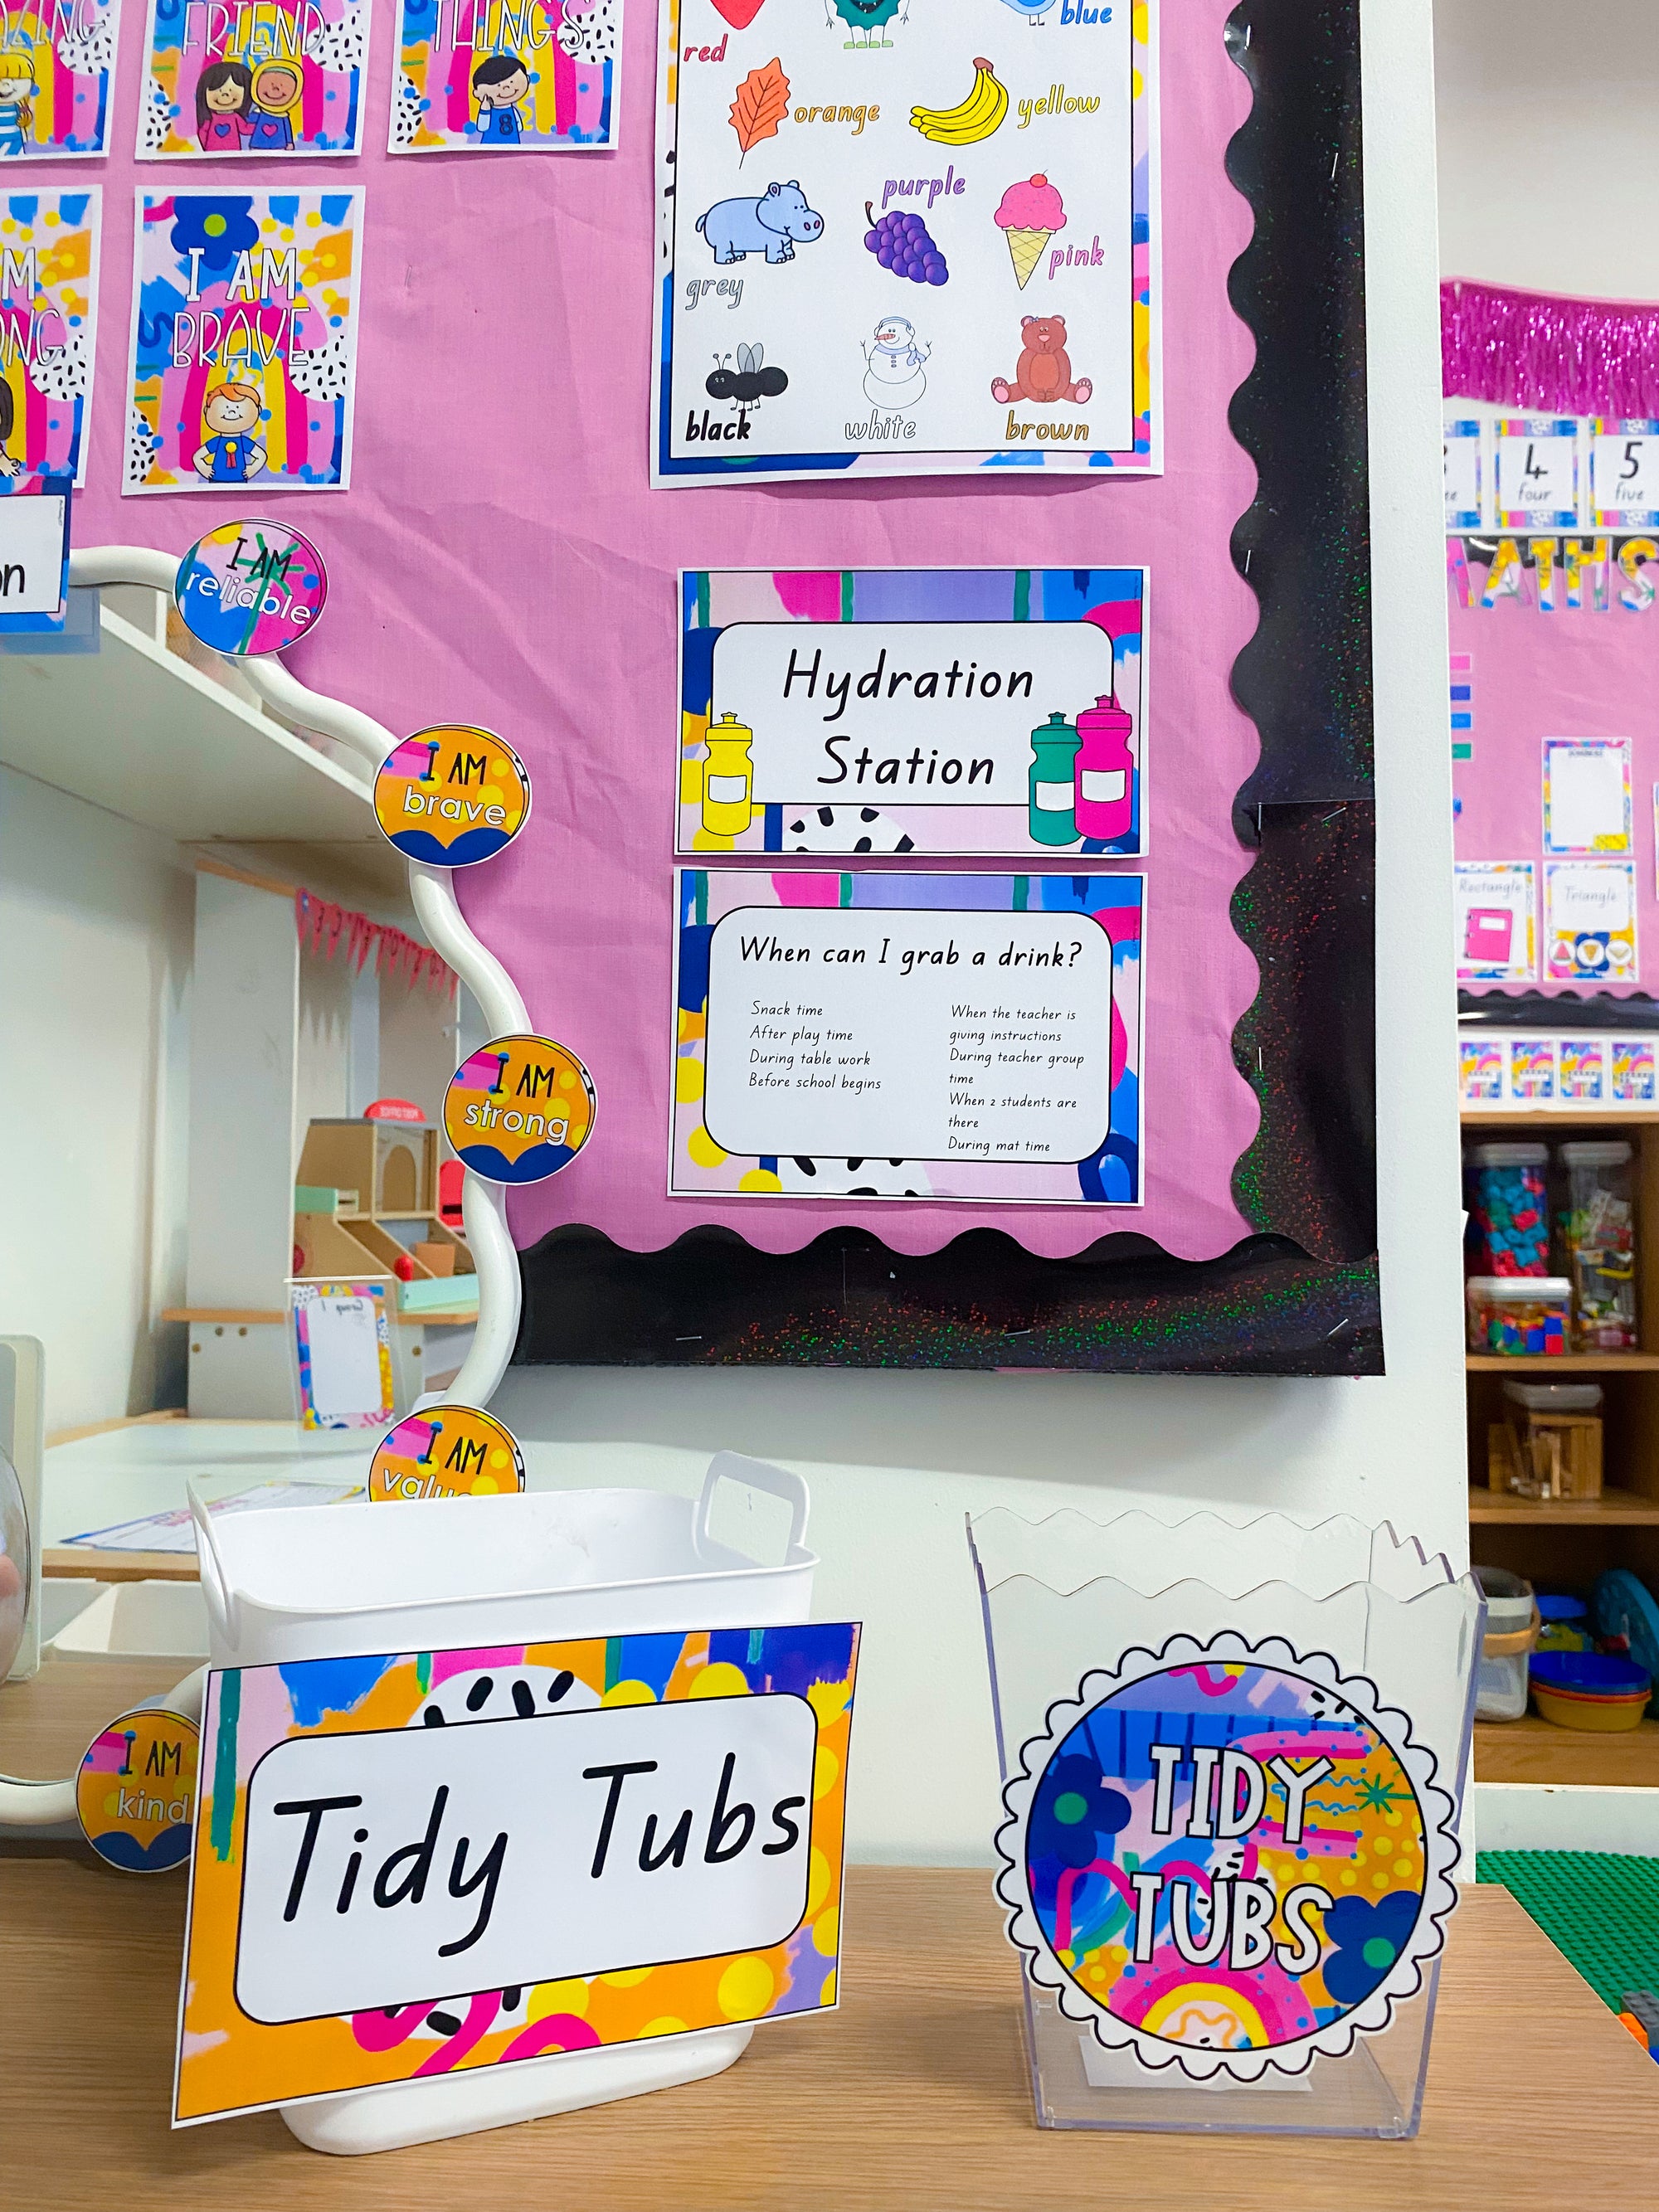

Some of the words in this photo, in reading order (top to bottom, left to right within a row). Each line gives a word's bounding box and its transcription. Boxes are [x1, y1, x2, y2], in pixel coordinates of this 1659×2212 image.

[0, 0, 105, 46] ZING
[182, 1, 326, 56] FRIEND
[433, 0, 585, 52] THINGS
[1061, 0, 1112, 24] blue
[684, 35, 727, 62] red
[794, 102, 879, 135] orange
[1017, 85, 1100, 129] yellow
[882, 166, 966, 208] purple
[185, 247, 205, 302] I
[226, 248, 297, 301] AM
[1049, 236, 1104, 279] pink
[685, 276, 743, 310] grey
[0, 309, 64, 367] NG
[173, 308, 310, 368] BRAVE
[685, 411, 751, 441] black
[844, 411, 916, 440] white
[1006, 411, 1088, 441] brown
[1525, 443, 1549, 479] 4
[1619, 440, 1643, 479] 5
[226, 537, 248, 571] I
[250, 547, 292, 581] AM
[185, 571, 311, 625] reliable
[783, 649, 1033, 722] Hydration
[422, 746, 440, 781] I
[447, 752, 487, 785] AM
[817, 736, 995, 785] Station
[402, 785, 506, 825] brave
[1459, 878, 1523, 899] Rectangle
[1564, 885, 1618, 908] Triangle
[741, 936, 810, 963] When
[823, 949, 866, 964] can
[878, 938, 891, 964] I
[899, 939, 960, 976] grab
[971, 951, 985, 966] a
[998, 941, 1082, 968] drink?
[751, 1000, 791, 1015] Snack
[796, 1004, 823, 1016] time
[951, 1004, 987, 1018] When
[992, 1005, 1010, 1019] the
[1016, 1006, 1062, 1020] teacher
[1067, 1009, 1076, 1020] is
[749, 1024, 787, 1039] After
[791, 1025, 820, 1047] play
[826, 1029, 853, 1041] time
[949, 1030, 985, 1046] giving
[990, 1030, 1062, 1042] instructions
[491, 1056, 509, 1094] I
[515, 1063, 555, 1098] AM
[749, 1048, 795, 1070] During
[800, 1050, 832, 1065] table
[838, 1051, 871, 1066] work
[950, 1048, 992, 1068] During
[997, 1049, 1044, 1063] teacher
[1048, 1055, 1084, 1069] group
[748, 1072, 790, 1087] Before
[795, 1073, 836, 1088] school
[841, 1074, 882, 1096] begins
[949, 1074, 974, 1084] time
[950, 1091, 985, 1106] When
[990, 1098, 996, 1106] 2
[1000, 1093, 1052, 1108] students
[1057, 1100, 1078, 1108] are
[464, 1099, 569, 1146] strong
[948, 1114, 979, 1128] there
[947, 1135, 990, 1156] During
[995, 1140, 1020, 1151] mat
[1025, 1141, 1050, 1152] time
[420, 1427, 441, 1465] I
[444, 1436, 488, 1475] AM
[119, 1736, 136, 1774] I
[145, 1740, 182, 1777] AM
[117, 1787, 190, 1824] kind
[1151, 1743, 1335, 1844] TIDY
[273, 1785, 508, 1957] Tidy
[582, 1753, 806, 1878] Tubs
[1129, 1873, 1333, 1974] TUBS
